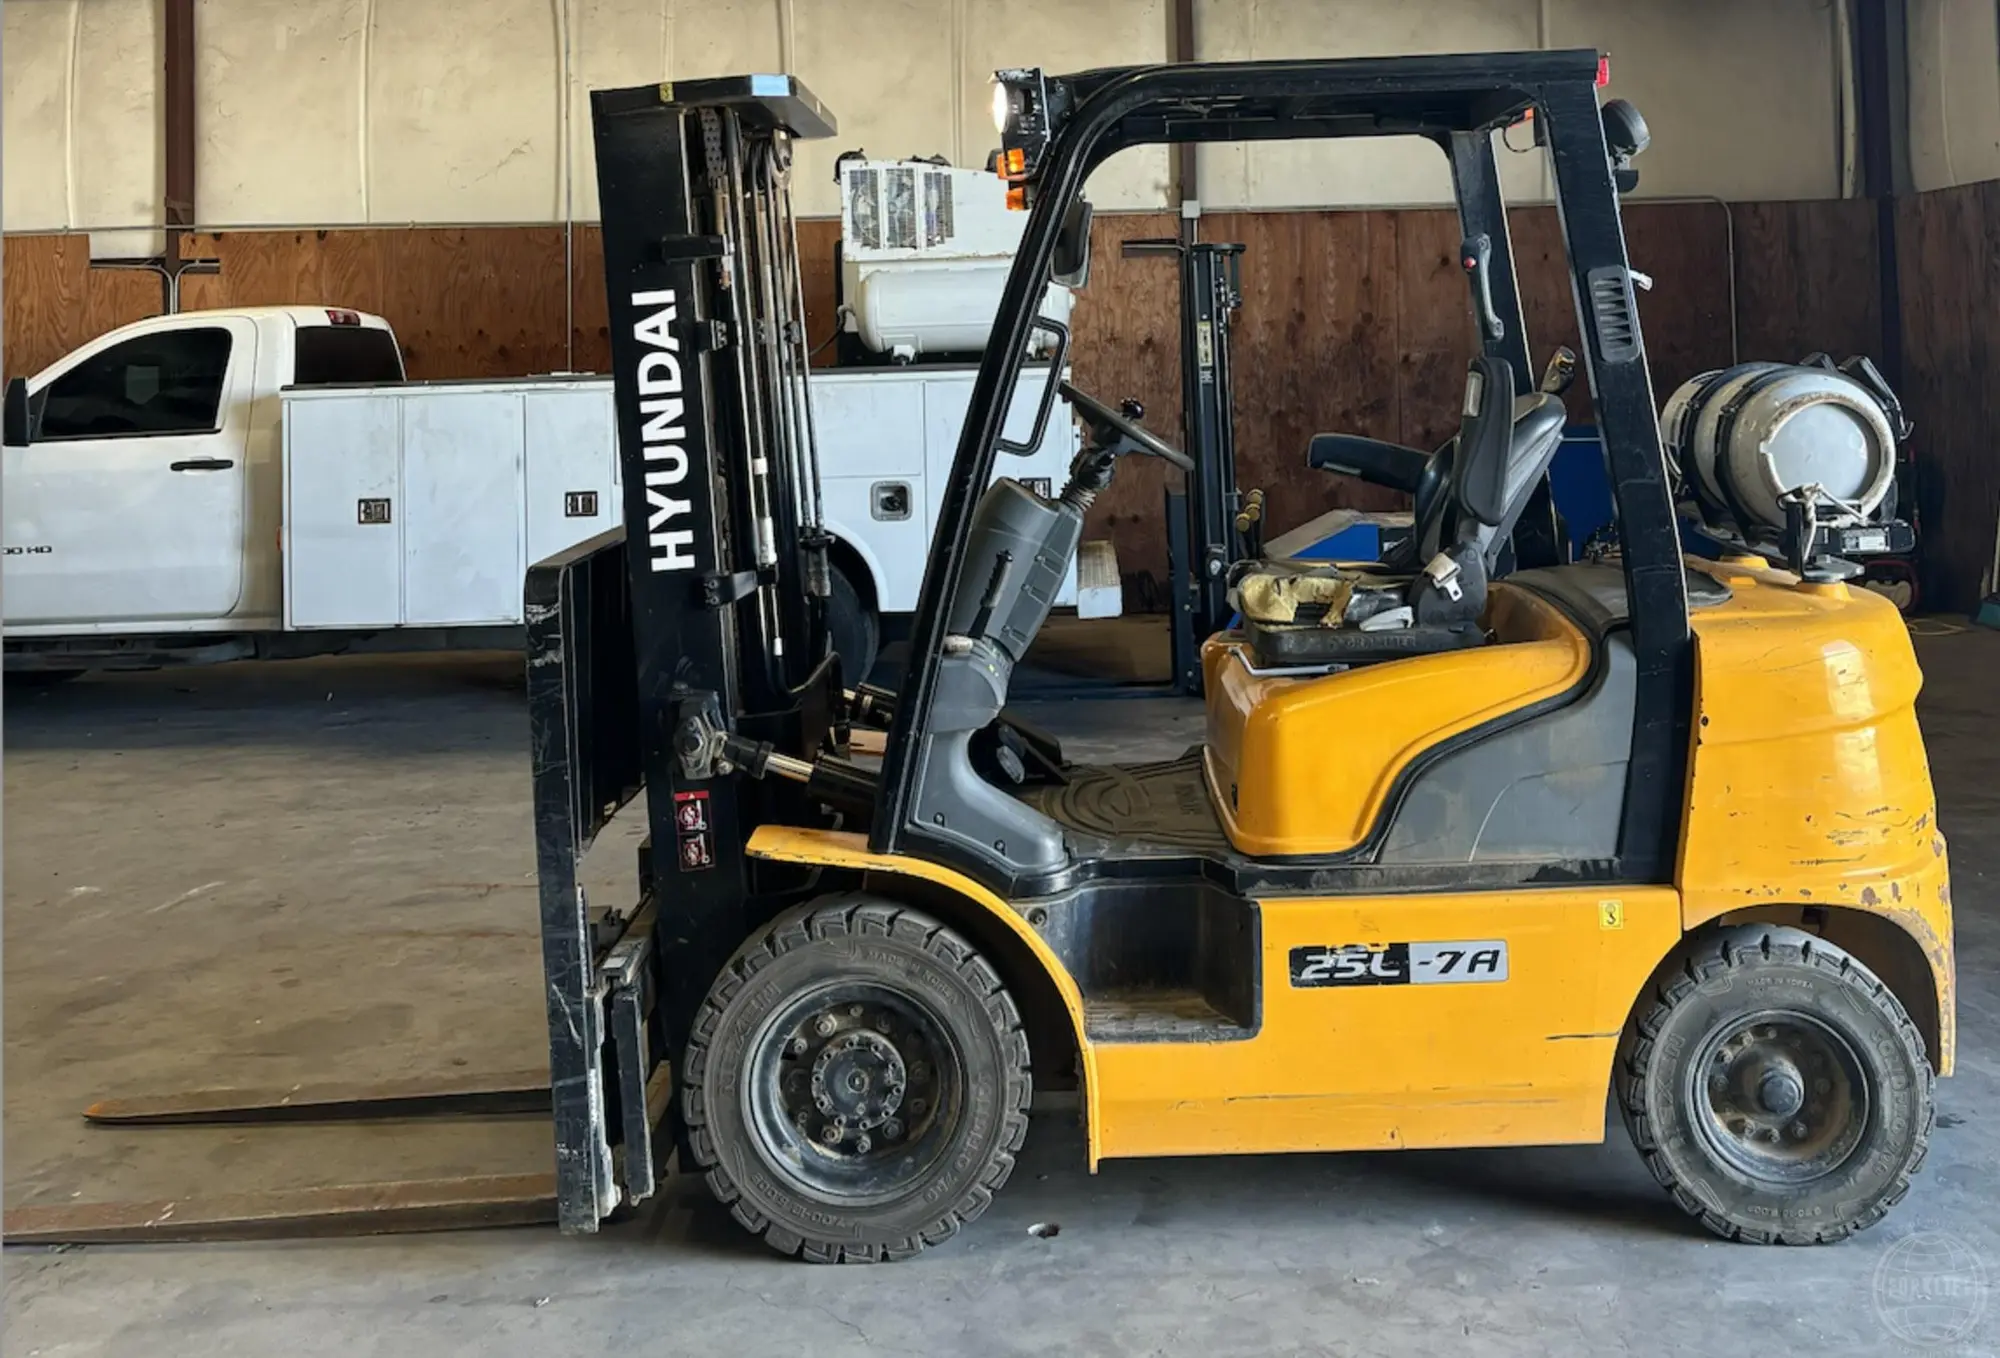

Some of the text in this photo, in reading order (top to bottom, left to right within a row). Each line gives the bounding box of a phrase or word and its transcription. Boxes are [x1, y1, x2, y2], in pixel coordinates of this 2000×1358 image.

[631, 289, 696, 572] HYUNDAI
[27, 545, 52, 553] HD
[922, 968, 959, 1006] KOREA
